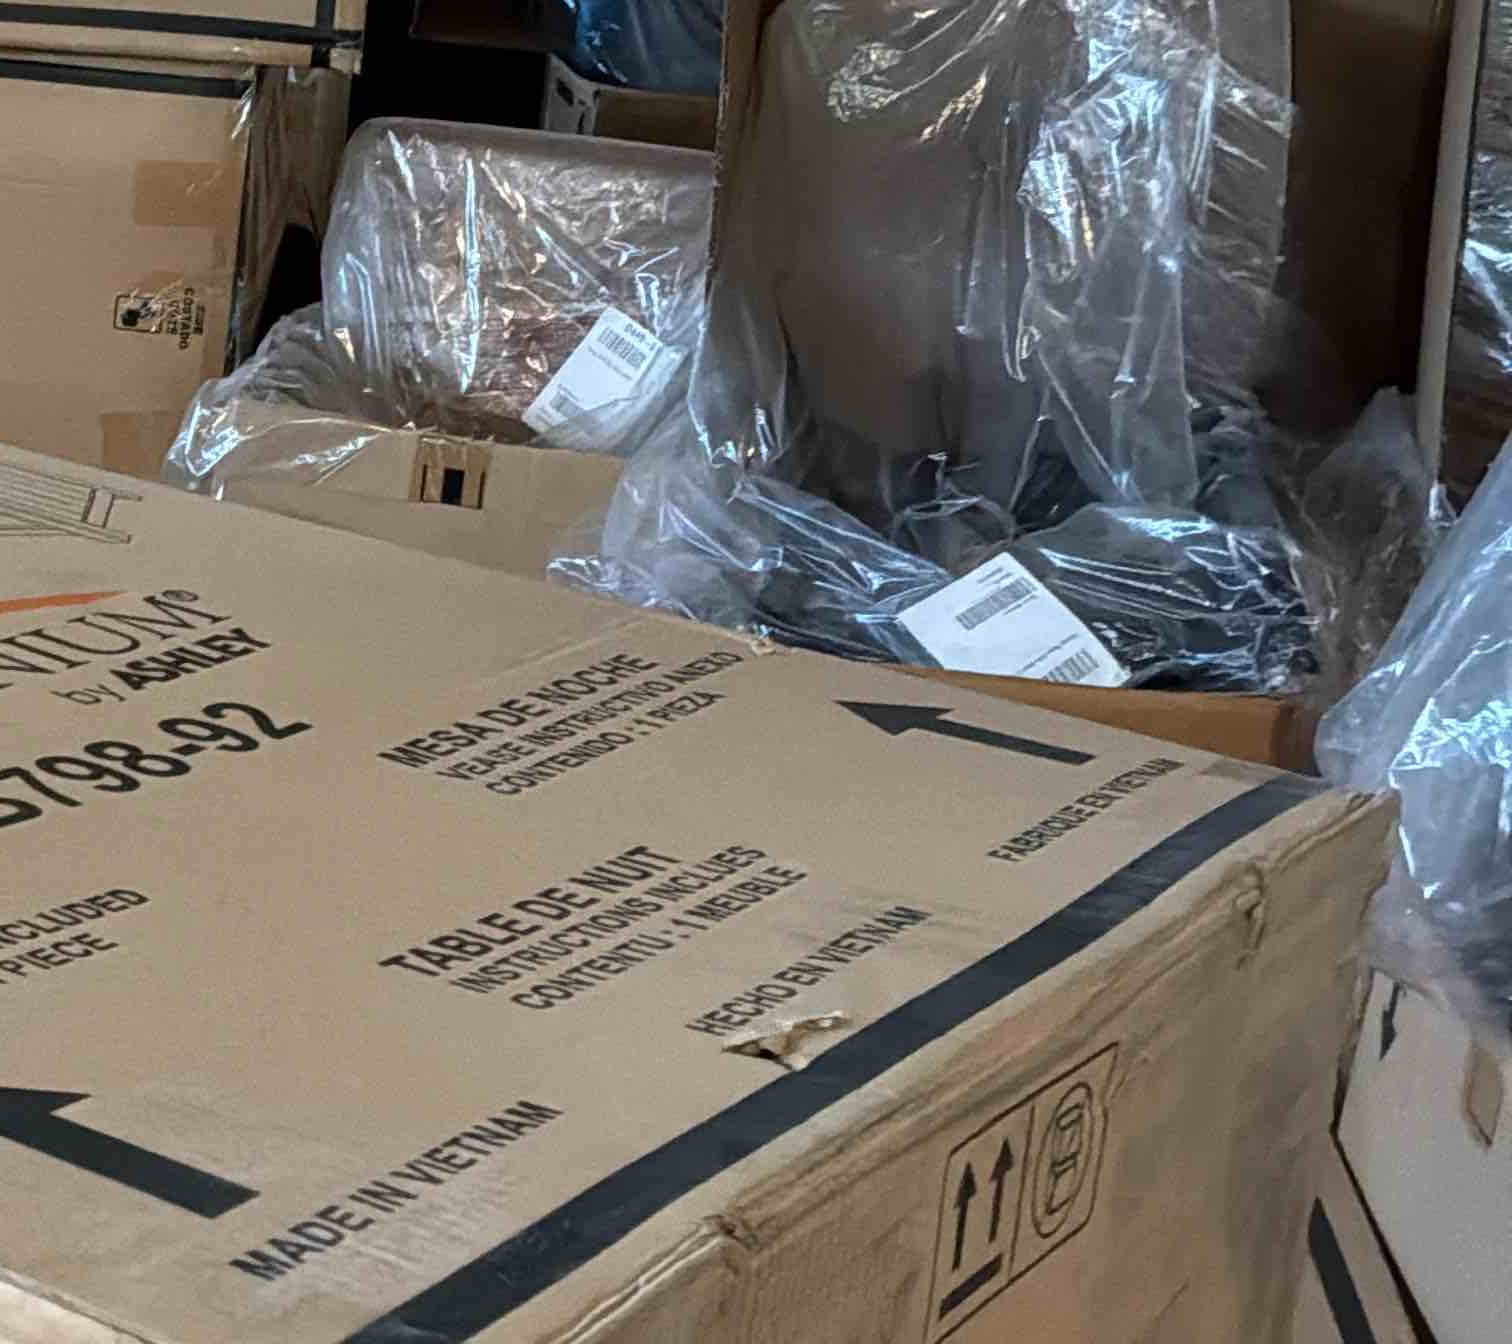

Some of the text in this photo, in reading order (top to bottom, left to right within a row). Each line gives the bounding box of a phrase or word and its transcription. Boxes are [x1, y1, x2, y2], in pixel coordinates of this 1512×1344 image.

[50, 627, 272, 706] by ASHLEY
[377, 653, 661, 768] MESA DE NOCHE
[435, 651, 745, 782] VEASE INSTRUCTIVO ANEXO
[485, 730, 635, 796] CONTENIDO
[645, 689, 728, 723] PIEZA
[986, 757, 1185, 863] FABRIQUE EN VIETNAM
[378, 845, 682, 977] TABLE DE NUIT
[449, 844, 768, 995] INSTRUCTIONS INCLUES
[683, 865, 808, 923] MEUBLE
[685, 906, 933, 1037] HECHO EN VIETNAM
[228, 1100, 564, 1282] MADE IN VIETNAM
